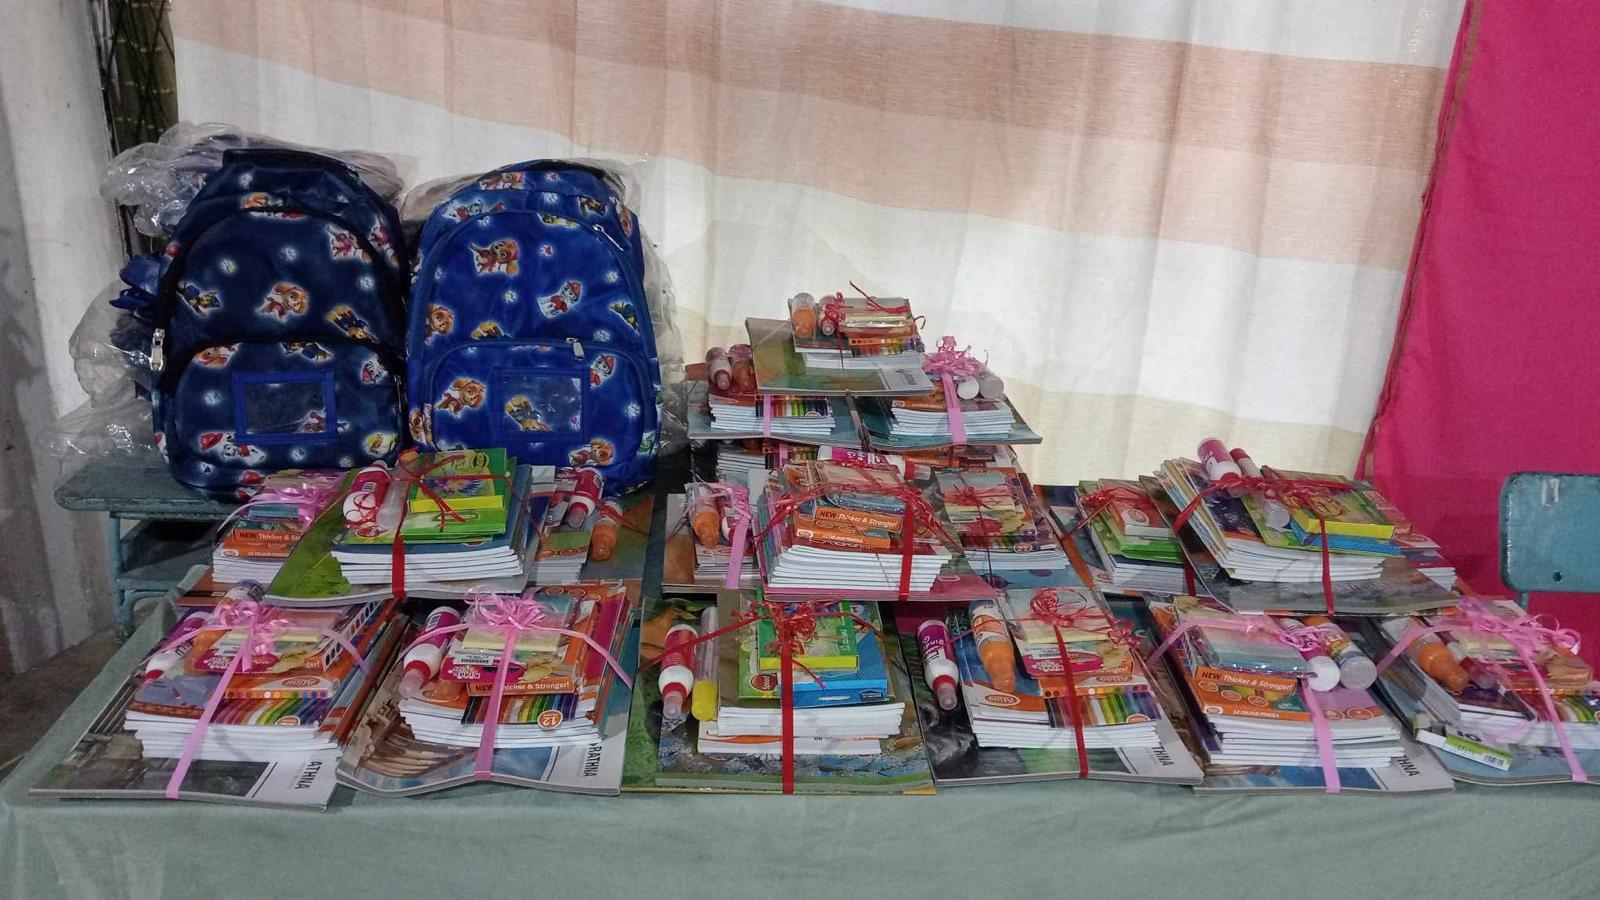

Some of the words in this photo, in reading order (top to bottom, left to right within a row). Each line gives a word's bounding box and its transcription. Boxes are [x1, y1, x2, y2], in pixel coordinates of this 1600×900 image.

[838, 513, 862, 522] Thicker
[868, 518, 898, 528] Stronger!
[240, 531, 256, 539] NEW
[258, 532, 282, 540] Thicker
[502, 683, 526, 691] hicker
[535, 680, 570, 691] Stronger!
[1202, 671, 1222, 680] NEW
[1223, 674, 1250, 685] Thicker
[1258, 680, 1293, 690] Stronger!
[542, 715, 558, 726] 12
